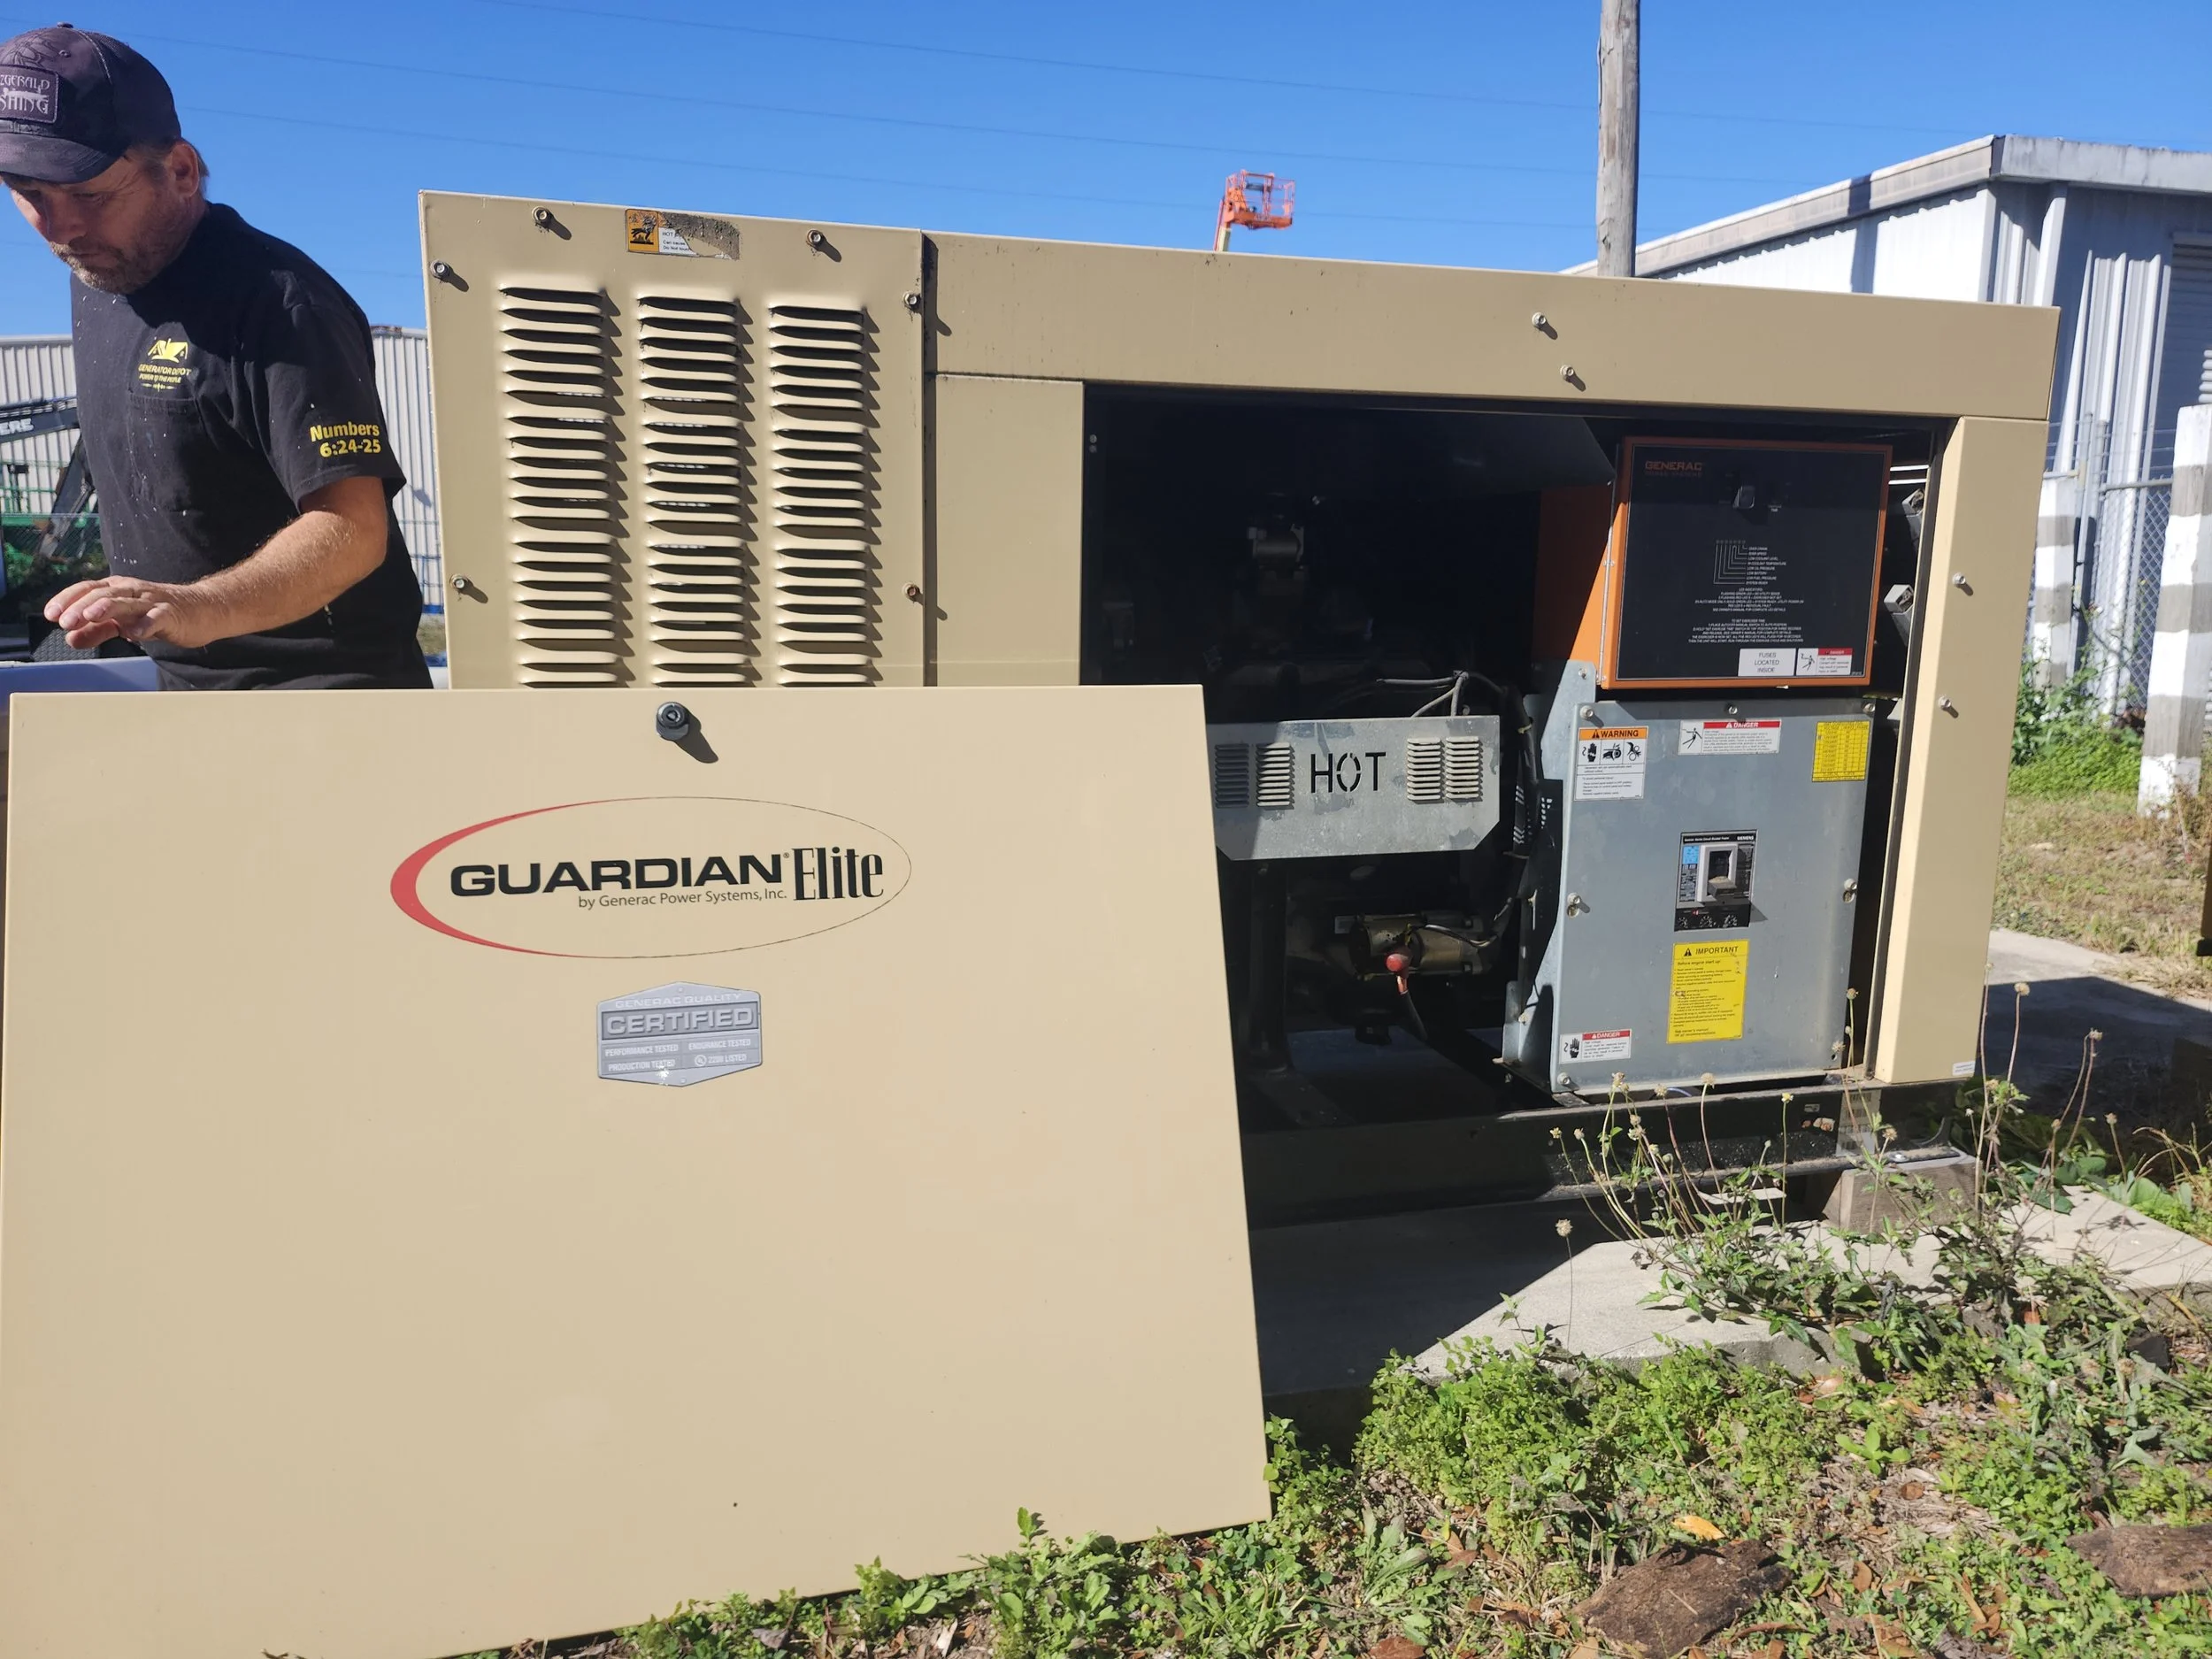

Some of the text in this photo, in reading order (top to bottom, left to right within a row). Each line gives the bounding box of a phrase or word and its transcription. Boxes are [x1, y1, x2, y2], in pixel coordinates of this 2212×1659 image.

[138, 364, 172, 375] GENERATOR
[310, 421, 380, 442] Numbers
[319, 439, 381, 457] 6:24-25
[1645, 460, 1703, 471] GENERAC
[1310, 751, 1386, 794] HOT
[791, 846, 884, 901] Elite
[579, 888, 787, 910] by Generac Power Systems, Inc.
[1695, 946, 1739, 956] IMPORTANT
[615, 993, 741, 1009] GENERAC QUALITY
[606, 1007, 754, 1035] CERTIFIED
[605, 1044, 679, 1057] PERFORMANCE TESTED
[725, 1054, 747, 1063] LISTED
[609, 1059, 676, 1071] PRODUCTION TESTED
